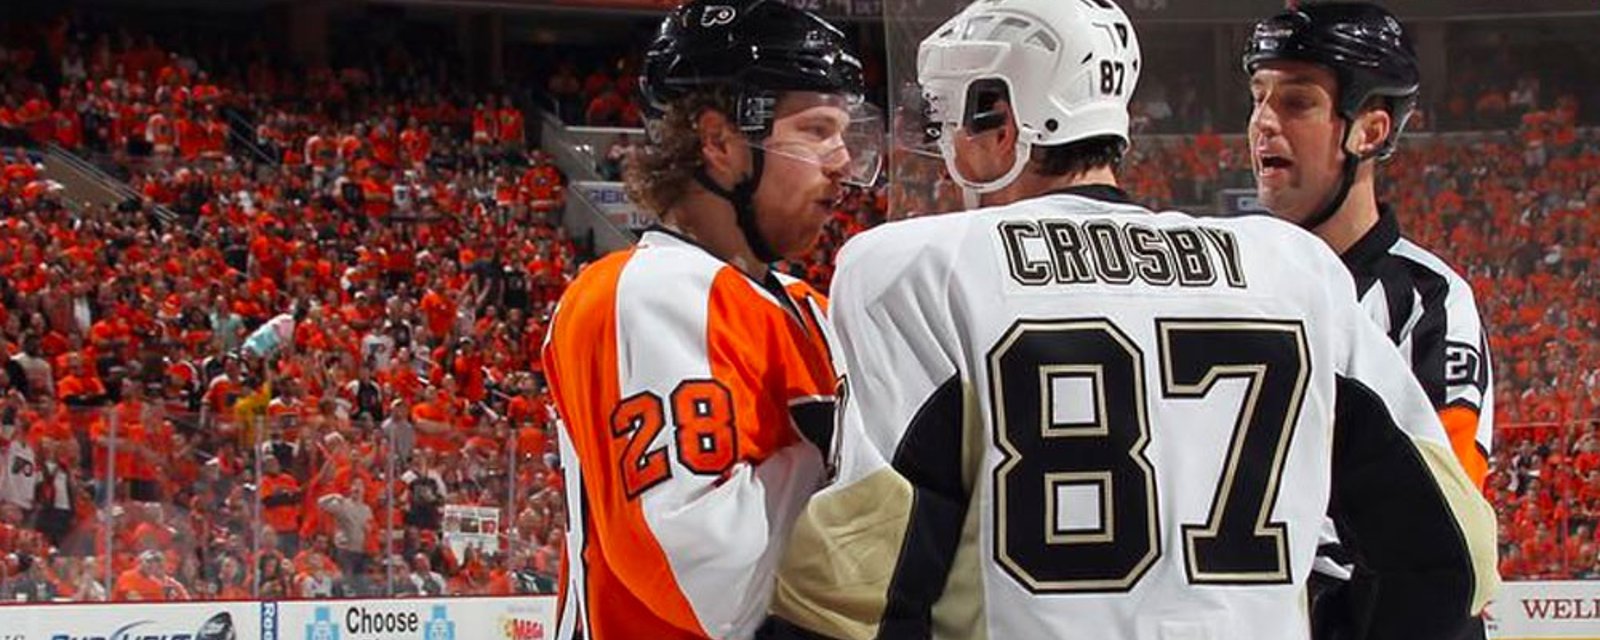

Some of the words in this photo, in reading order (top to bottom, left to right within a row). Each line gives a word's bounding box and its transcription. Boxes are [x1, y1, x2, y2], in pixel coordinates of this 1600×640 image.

[1099, 59, 1126, 97] 87
[997, 219, 1247, 288] CROSBY
[1445, 346, 1480, 382] 27
[609, 378, 738, 501] 28
[986, 316, 1313, 595] 87
[346, 606, 419, 634] Choose
